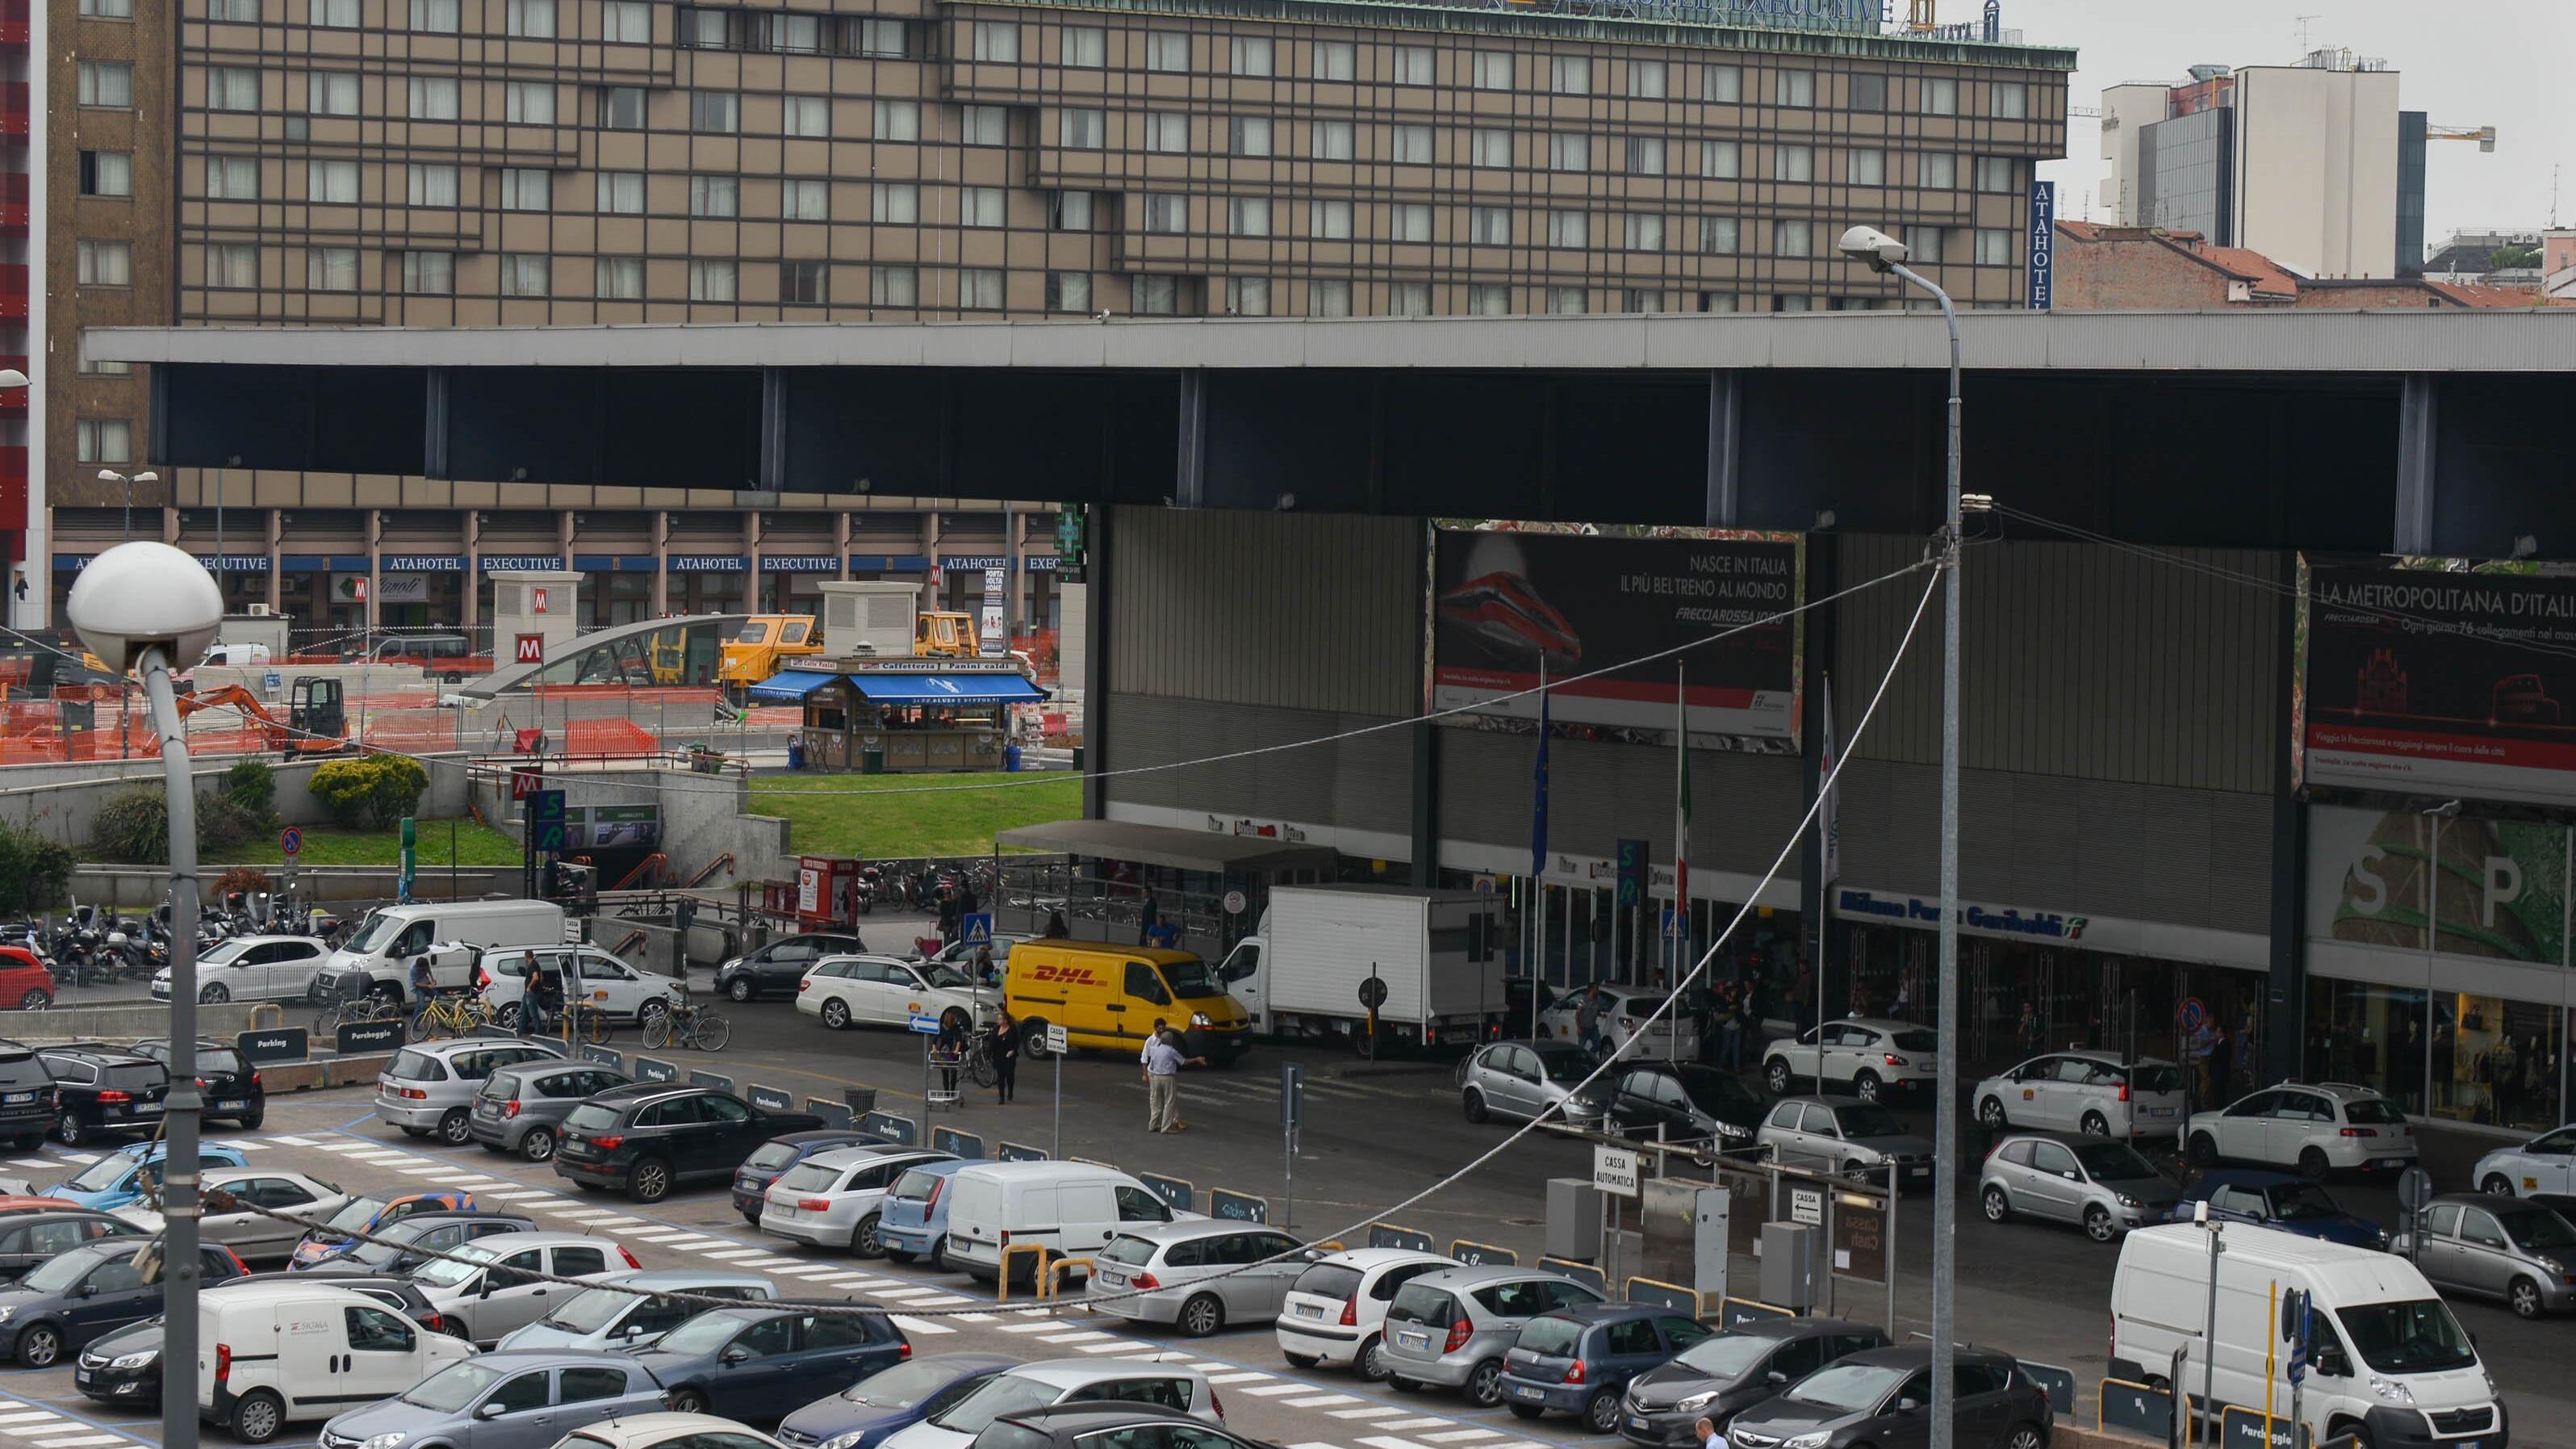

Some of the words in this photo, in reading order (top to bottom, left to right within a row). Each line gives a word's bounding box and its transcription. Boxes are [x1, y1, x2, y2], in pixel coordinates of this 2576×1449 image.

[196, 558, 267, 570] XECUTIVE
[391, 558, 460, 570] ATAHOTEL
[484, 558, 560, 570] EXECUTIVE
[676, 559, 742, 570] ATAHOTEL
[764, 558, 837, 570] EXECUTIVE
[1690, 555, 1730, 573] NASCE
[1734, 558, 1749, 574] IN
[1750, 557, 1788, 576] ITALIA
[985, 570, 1004, 578] PORTA
[355, 582, 366, 597] M
[1621, 574, 1630, 593] IL
[1654, 575, 1675, 594] BEL
[1675, 578, 1715, 597] TRENO
[1717, 580, 1733, 598] AL
[1737, 580, 1787, 601] MONDO
[535, 593, 546, 609] M
[2320, 581, 2342, 605] LA
[2347, 584, 2506, 614] METROPOLITANA
[2511, 593, 2576, 618] D'ITALI
[1675, 606, 1754, 624] FRECCIAROSSA
[2477, 625, 2536, 642] collegamenti
[2538, 628, 2553, 640] nel
[518, 640, 541, 659] M
[949, 662, 981, 670] Panini
[984, 662, 1009, 670] caldi
[516, 775, 538, 794] M
[2350, 844, 2387, 915] S
[2482, 856, 2522, 928] P
[1033, 965, 1094, 985] DHL
[351, 1029, 391, 1041] Parcheggio
[257, 1039, 286, 1049] Parking
[647, 1068, 666, 1082] Parking
[1604, 1155, 1626, 1171] CASSA
[1595, 1171, 1635, 1189] AUTOMATICA
[1796, 1193, 1816, 1203] CASSA
[2241, 1423, 2292, 1446] Parchggio
